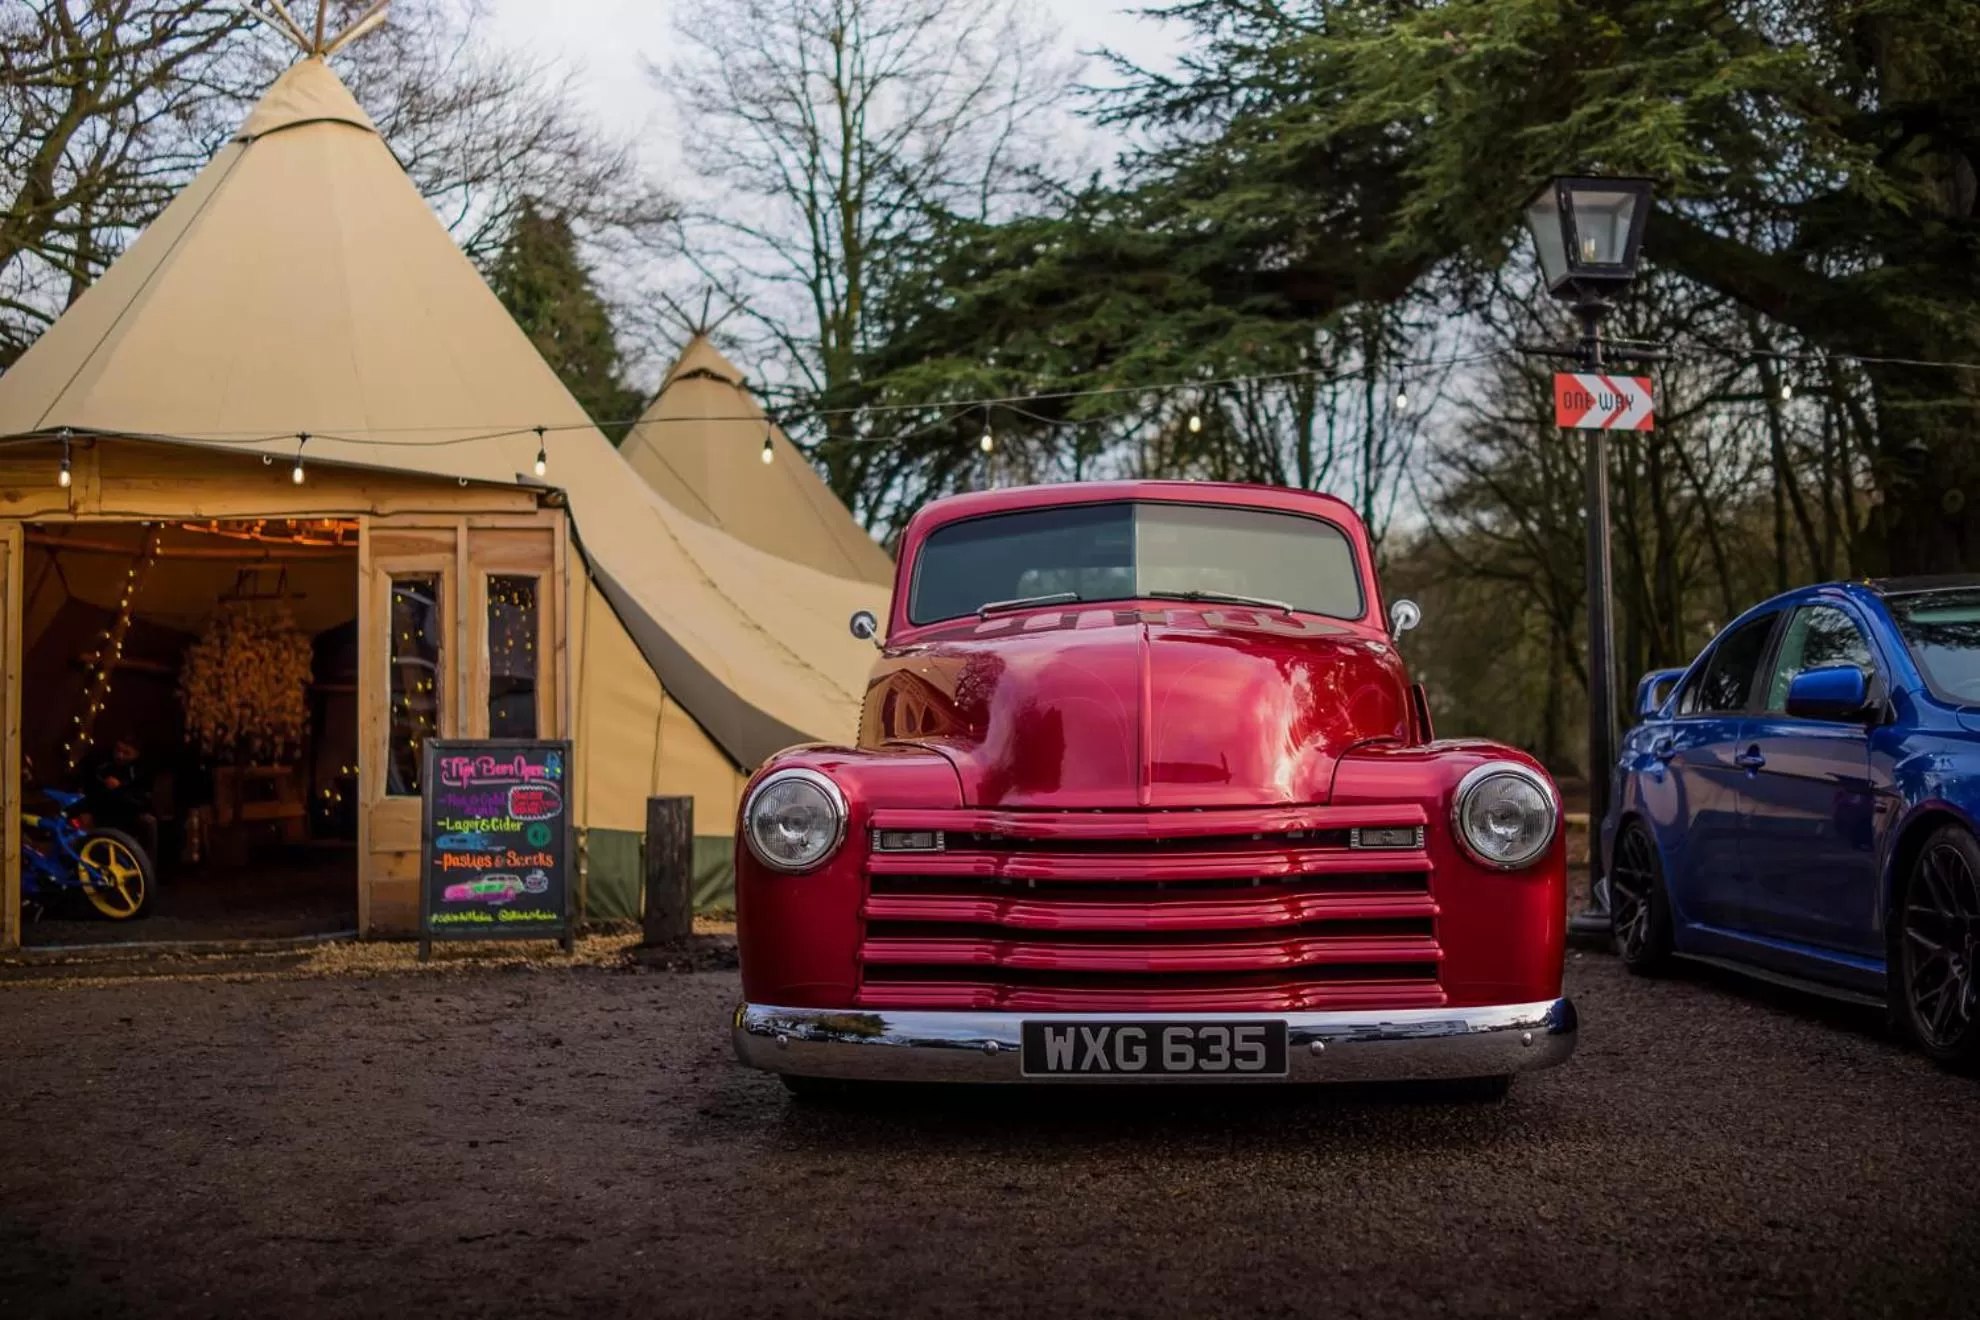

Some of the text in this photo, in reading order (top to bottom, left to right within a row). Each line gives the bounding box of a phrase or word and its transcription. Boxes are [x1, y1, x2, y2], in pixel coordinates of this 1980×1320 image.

[1563, 391, 1634, 412] ONE WAY
[1044, 1027, 1266, 1071] WXG 635
